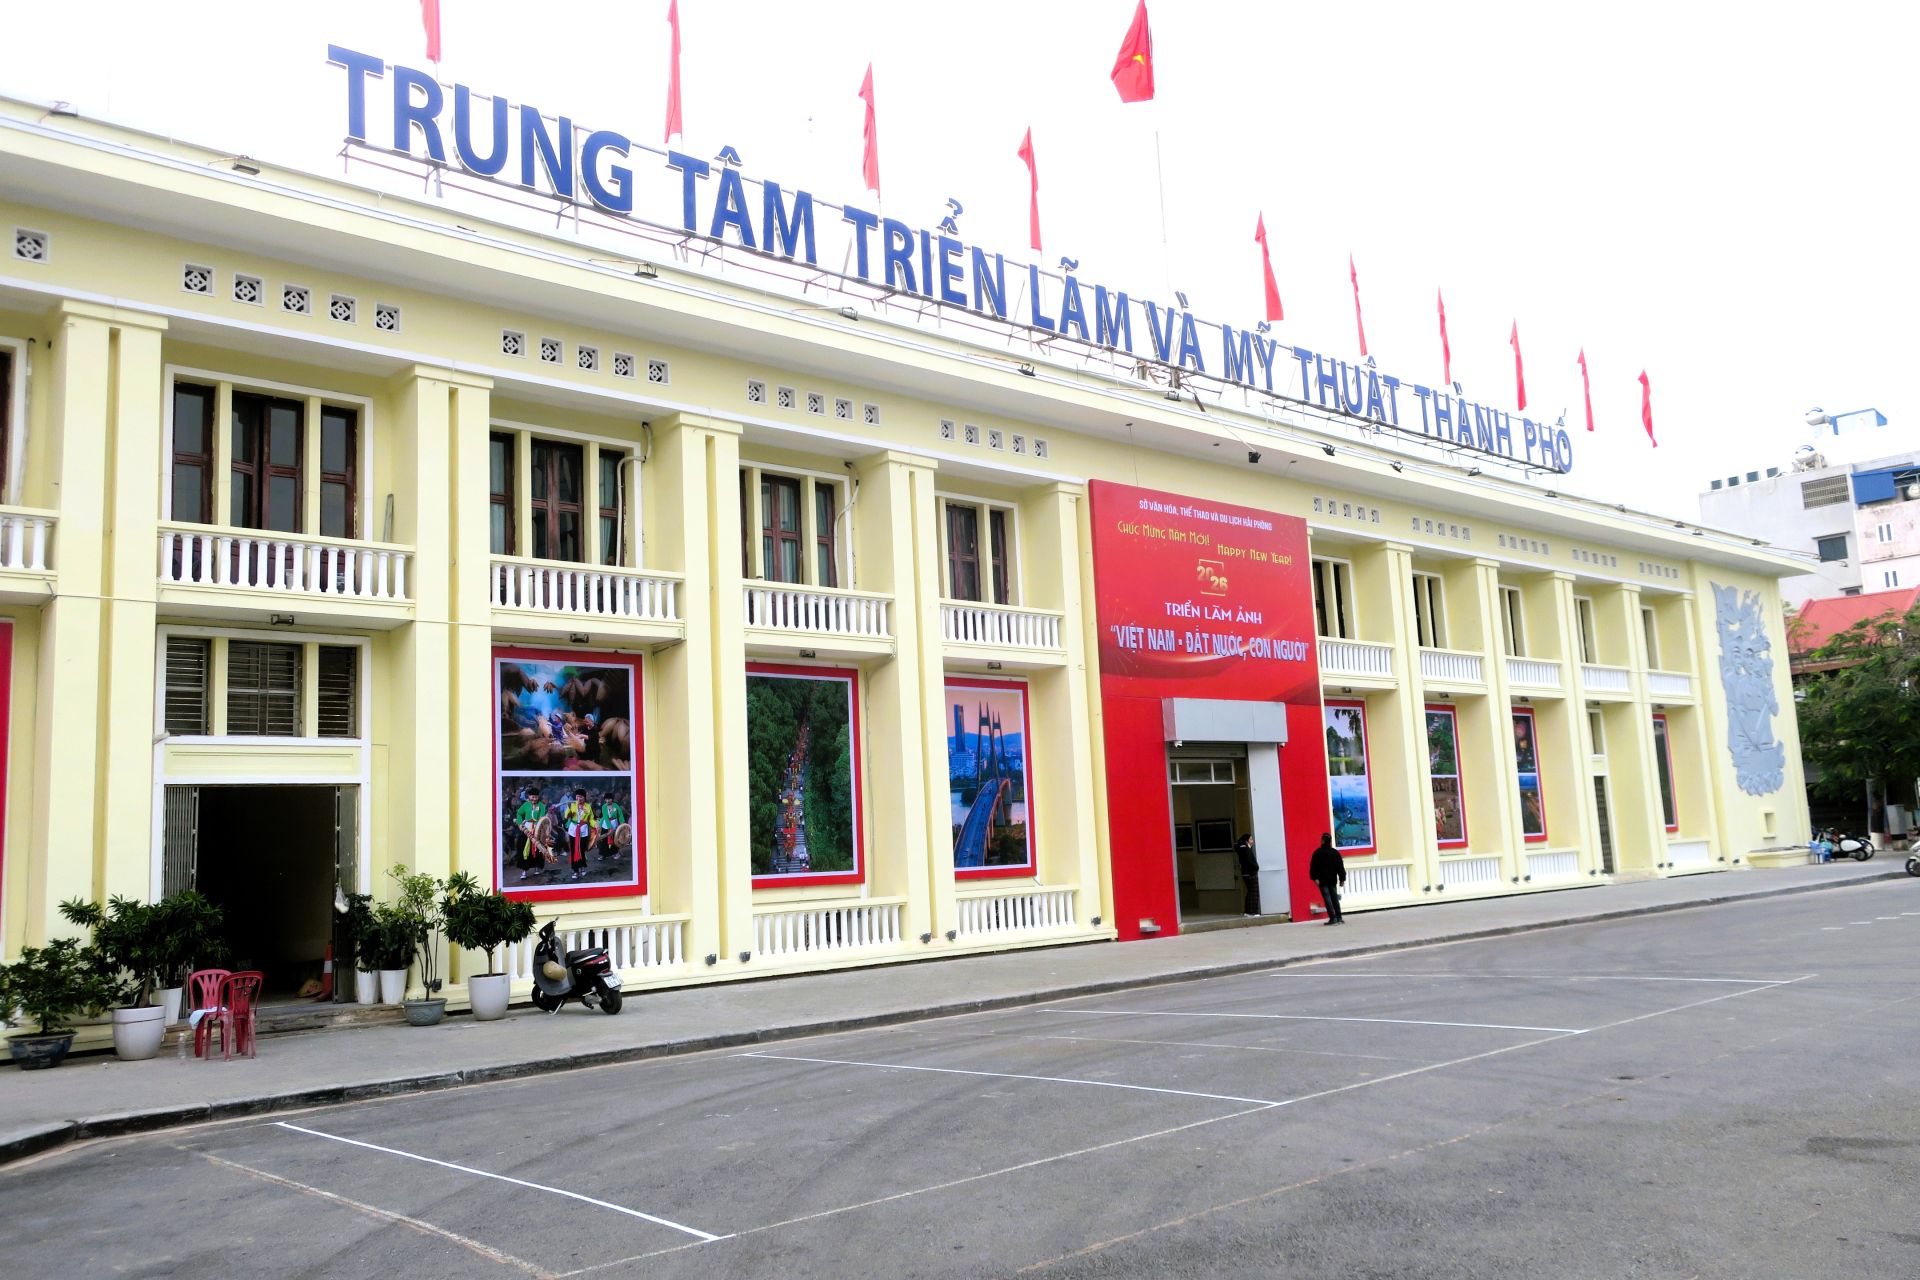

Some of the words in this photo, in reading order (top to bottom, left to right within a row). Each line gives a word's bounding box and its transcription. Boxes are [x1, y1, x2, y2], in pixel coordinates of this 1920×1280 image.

[328, 43, 633, 214] TRUNG
[668, 145, 818, 266] TÂM
[843, 198, 1007, 320] TRIỂN
[1029, 256, 1133, 353] LÃM
[1145, 291, 1205, 373] VÀ
[1222, 321, 1277, 391] MỸ
[1293, 356, 1400, 433] THUẬT
[1414, 381, 1513, 457] THÀNH
[1522, 408, 1573, 474] PHỐ
[1139, 498, 1148, 510] SỞ
[1148, 501, 1163, 512] VĂN
[1193, 509, 1210, 520] THAO
[1210, 511, 1219, 522] VÀ
[1219, 514, 1228, 524] DU
[1164, 600, 1200, 618] TRIỂN
[1204, 604, 1233, 622] LÃM
[1236, 605, 1262, 625] ẢNH
[1147, 628, 1176, 652] NAM
[1185, 624, 1209, 654] ĐẤT
[1249, 637, 1272, 659] CON
